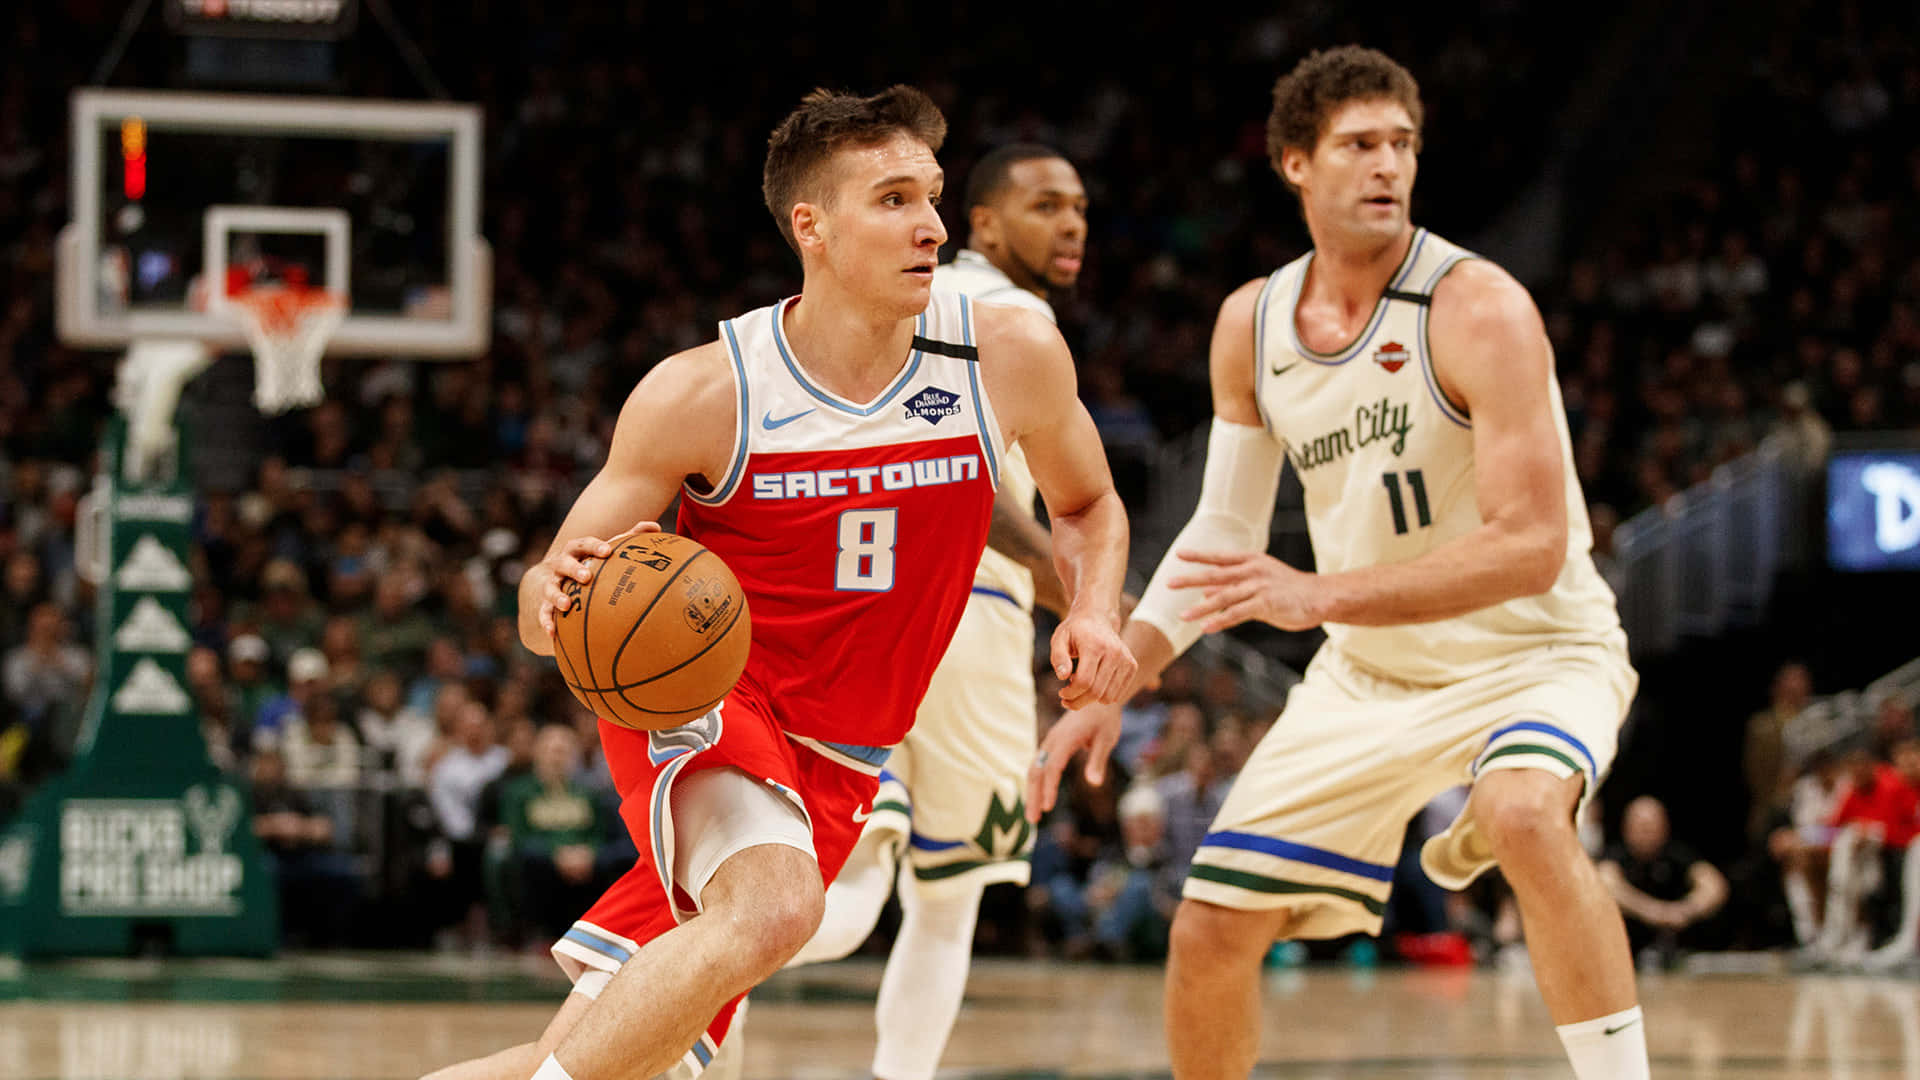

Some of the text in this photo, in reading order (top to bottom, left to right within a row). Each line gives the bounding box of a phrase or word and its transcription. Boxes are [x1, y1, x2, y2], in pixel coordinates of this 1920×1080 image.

[906, 406, 960, 418] ALMONDS
[1356, 397, 1415, 457] City
[753, 454, 979, 499] SACTOWN
[1382, 467, 1432, 535] 11
[834, 506, 899, 593] 8
